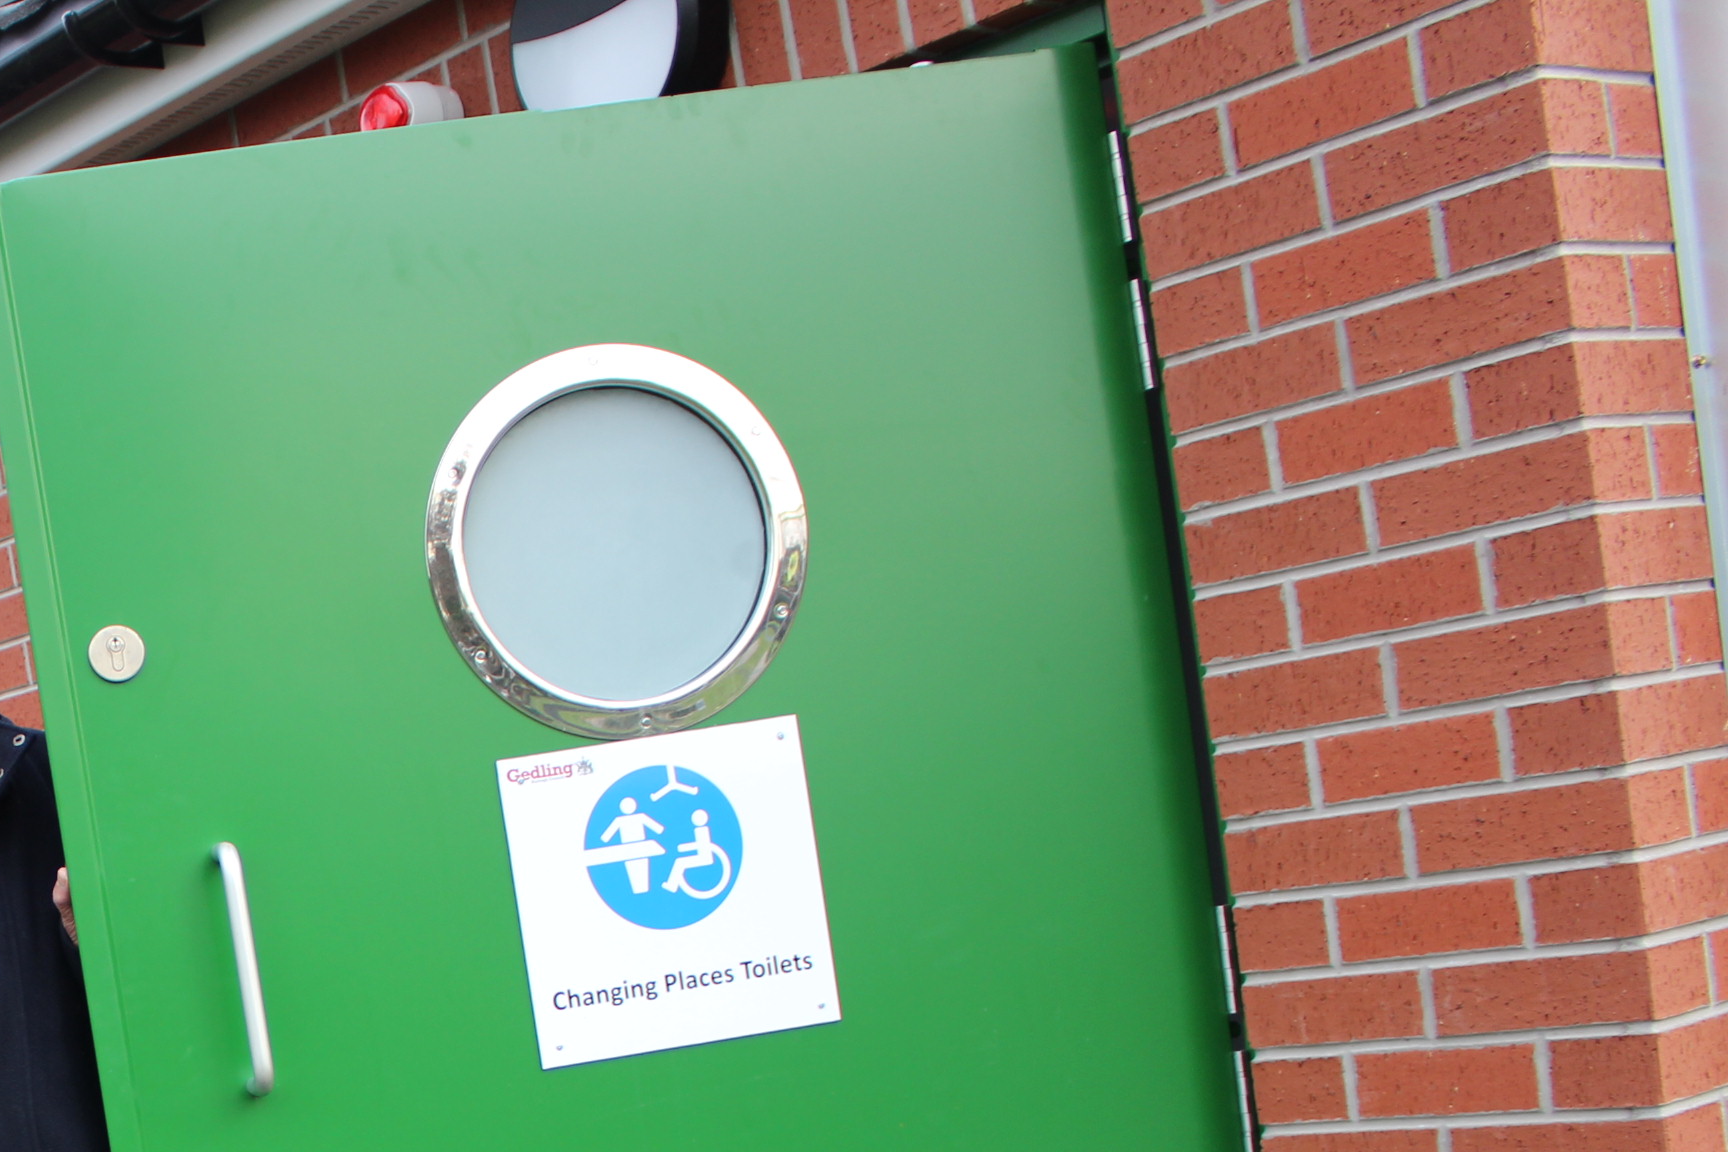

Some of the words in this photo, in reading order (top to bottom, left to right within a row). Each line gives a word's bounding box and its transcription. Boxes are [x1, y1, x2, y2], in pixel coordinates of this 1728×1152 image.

[507, 764, 572, 782] Gedling
[553, 980, 658, 1010] Changing
[664, 970, 734, 992] Places
[740, 954, 813, 980] Toilets
